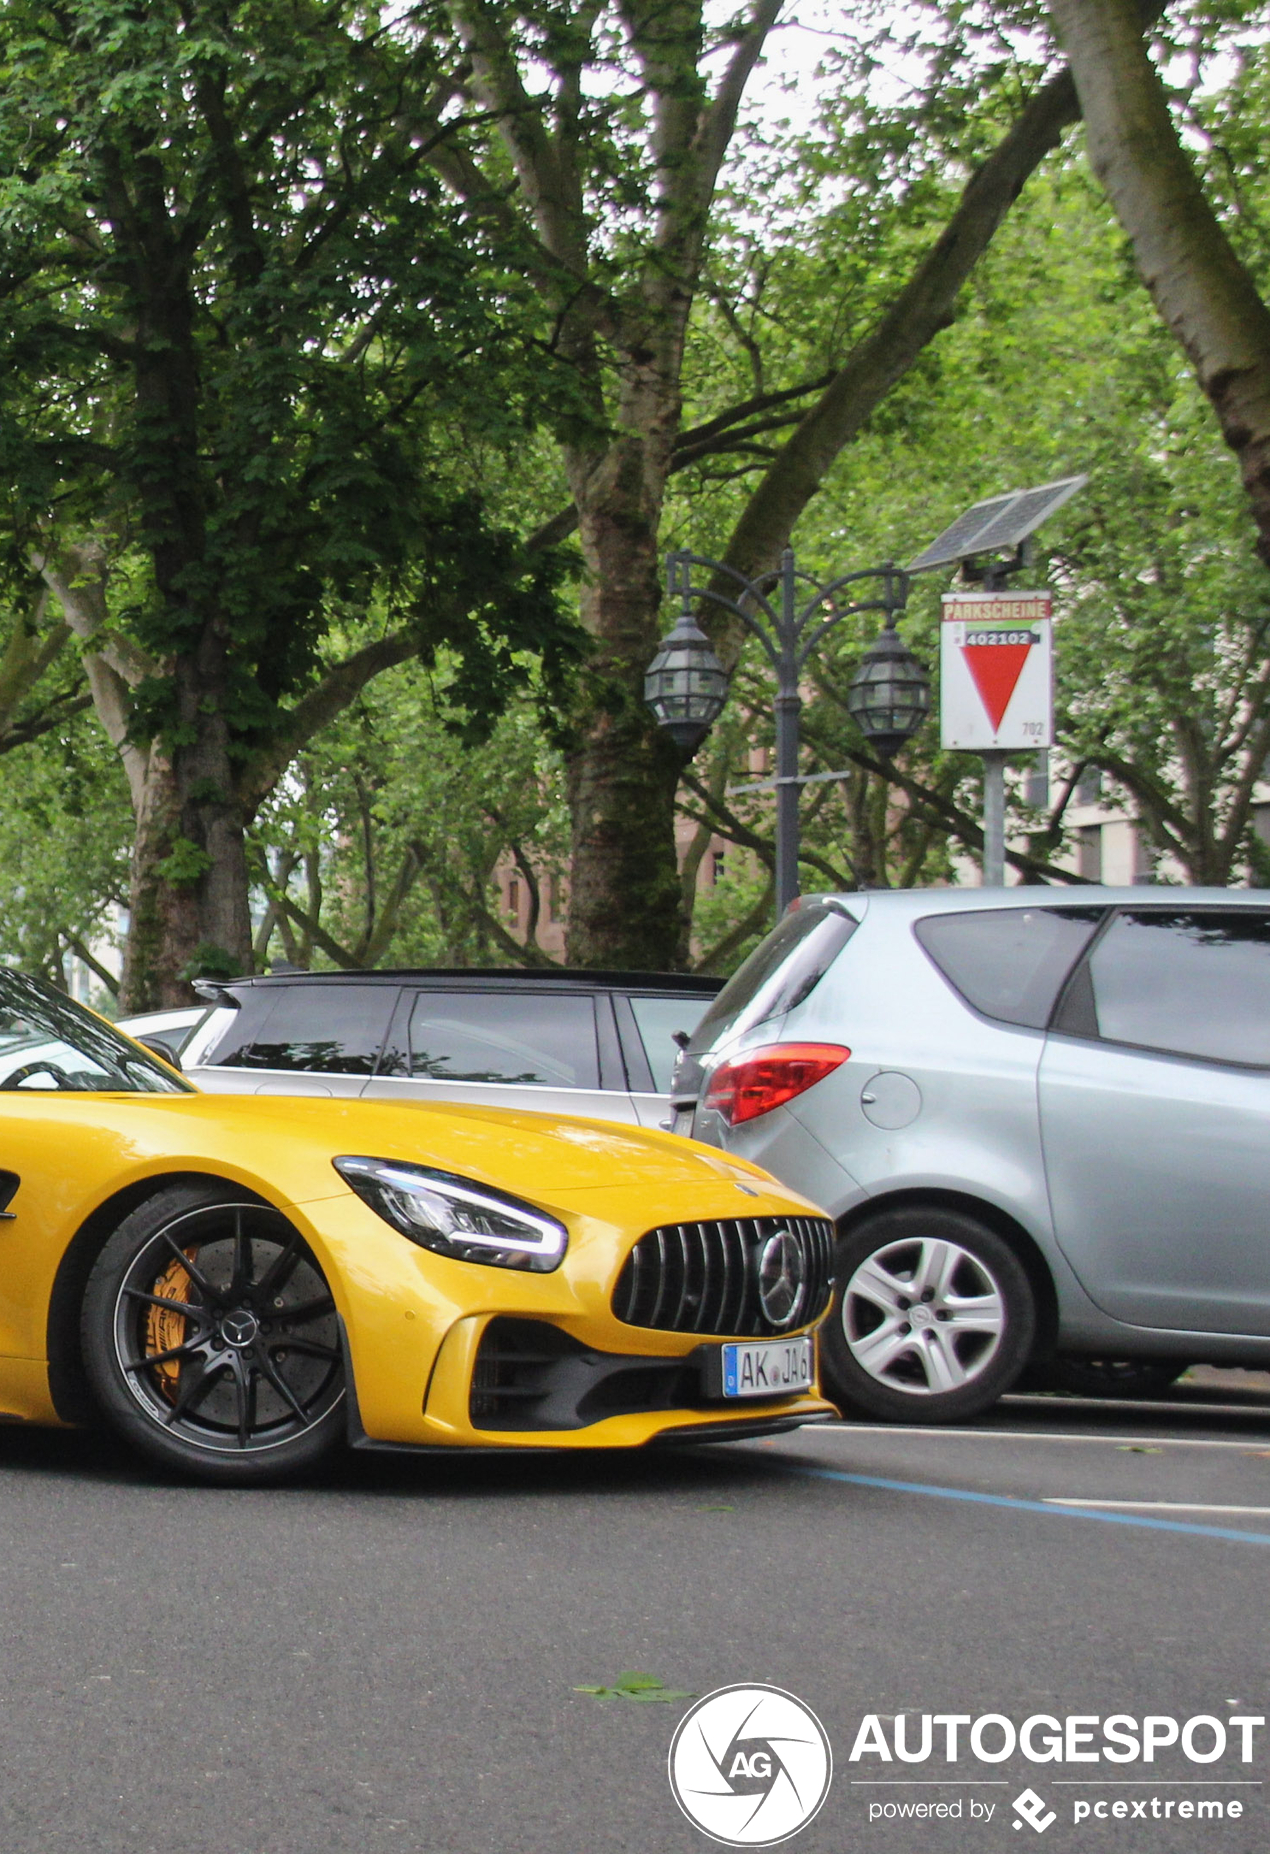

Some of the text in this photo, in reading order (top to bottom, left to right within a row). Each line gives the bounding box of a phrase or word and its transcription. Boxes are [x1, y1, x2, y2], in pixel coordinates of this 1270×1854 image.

[944, 602, 1046, 619] PARKSCHEINE
[967, 633, 1029, 645] 402102
[1023, 722, 1044, 735] 702
[741, 1351, 768, 1388] AK
[782, 1348, 798, 1383] JA
